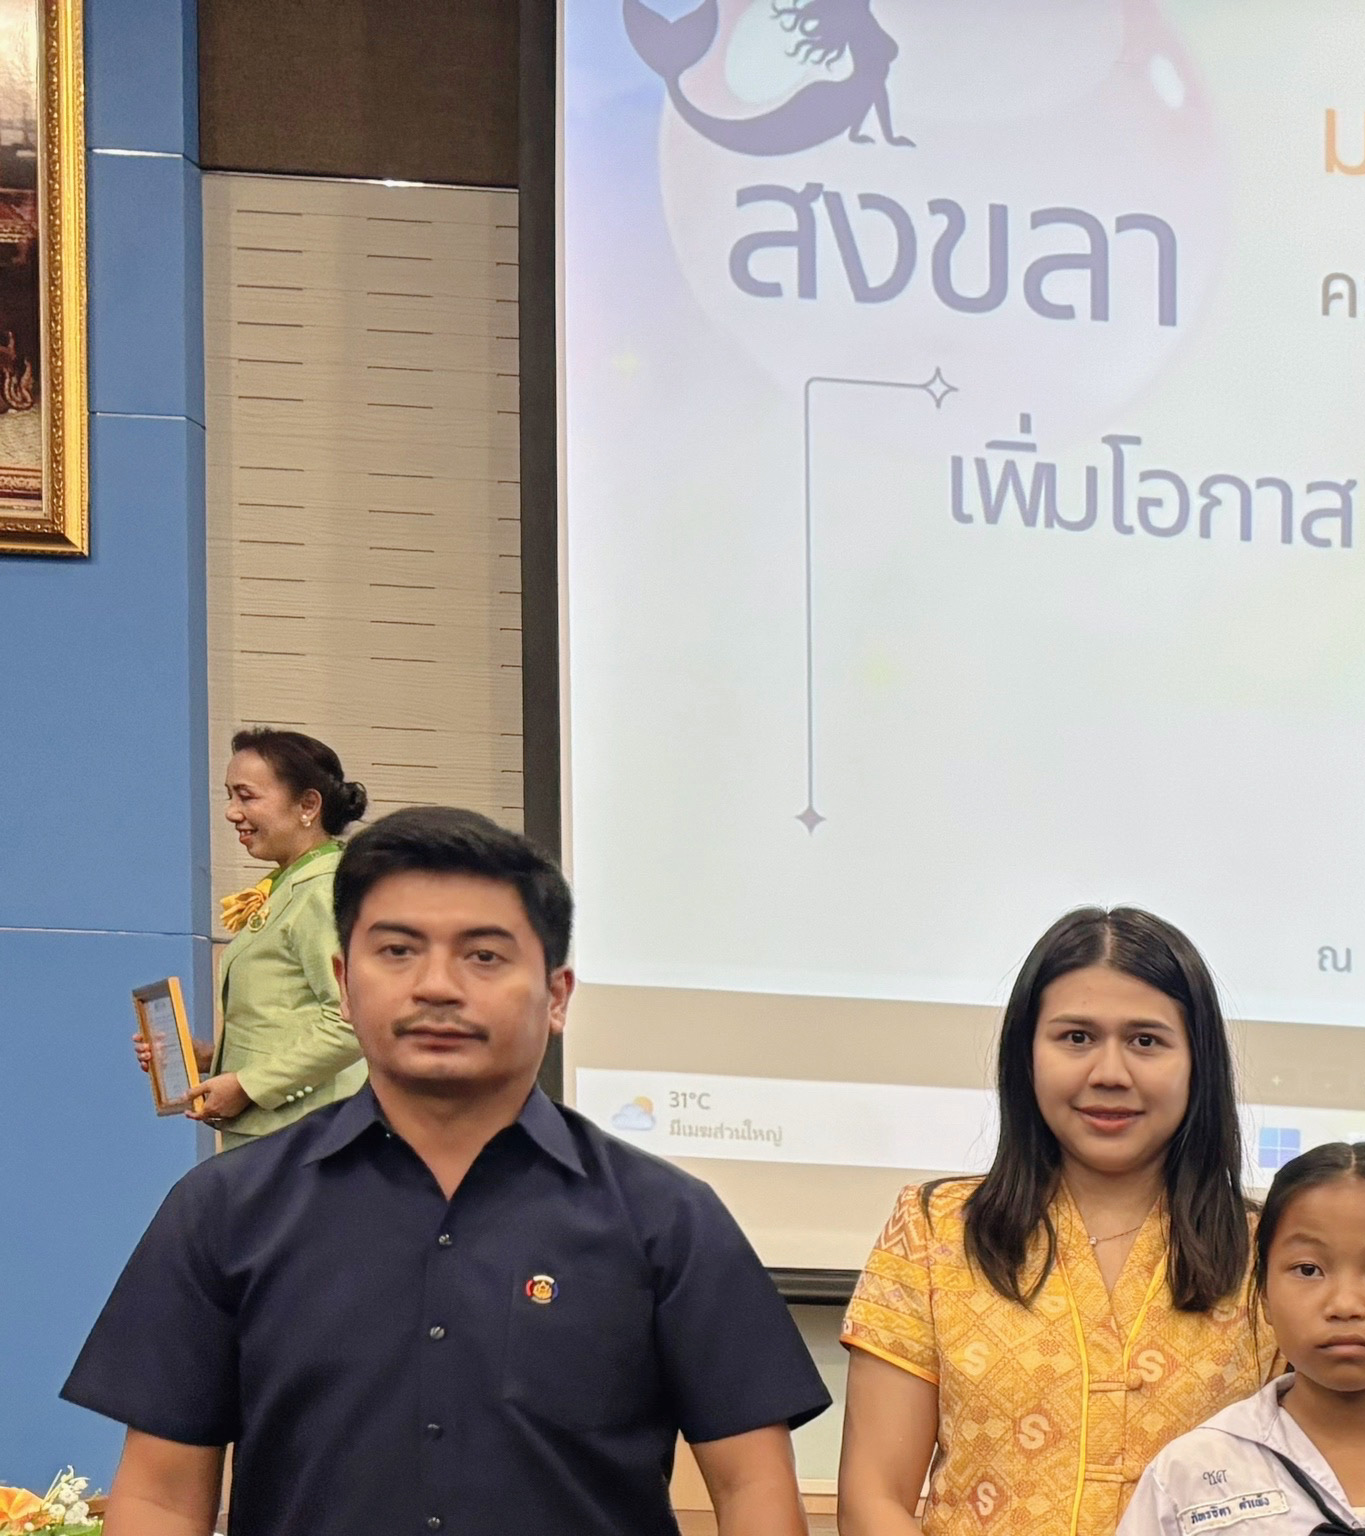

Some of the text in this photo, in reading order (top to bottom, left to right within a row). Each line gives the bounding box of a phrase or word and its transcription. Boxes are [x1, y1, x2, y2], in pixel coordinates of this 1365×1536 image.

[729, 182, 1177, 327] สงขลา
[950, 412, 1357, 549] เพิ่มโอกาส
[1317, 944, 1352, 974] ณ
[669, 1091, 711, 1110] 31°C
